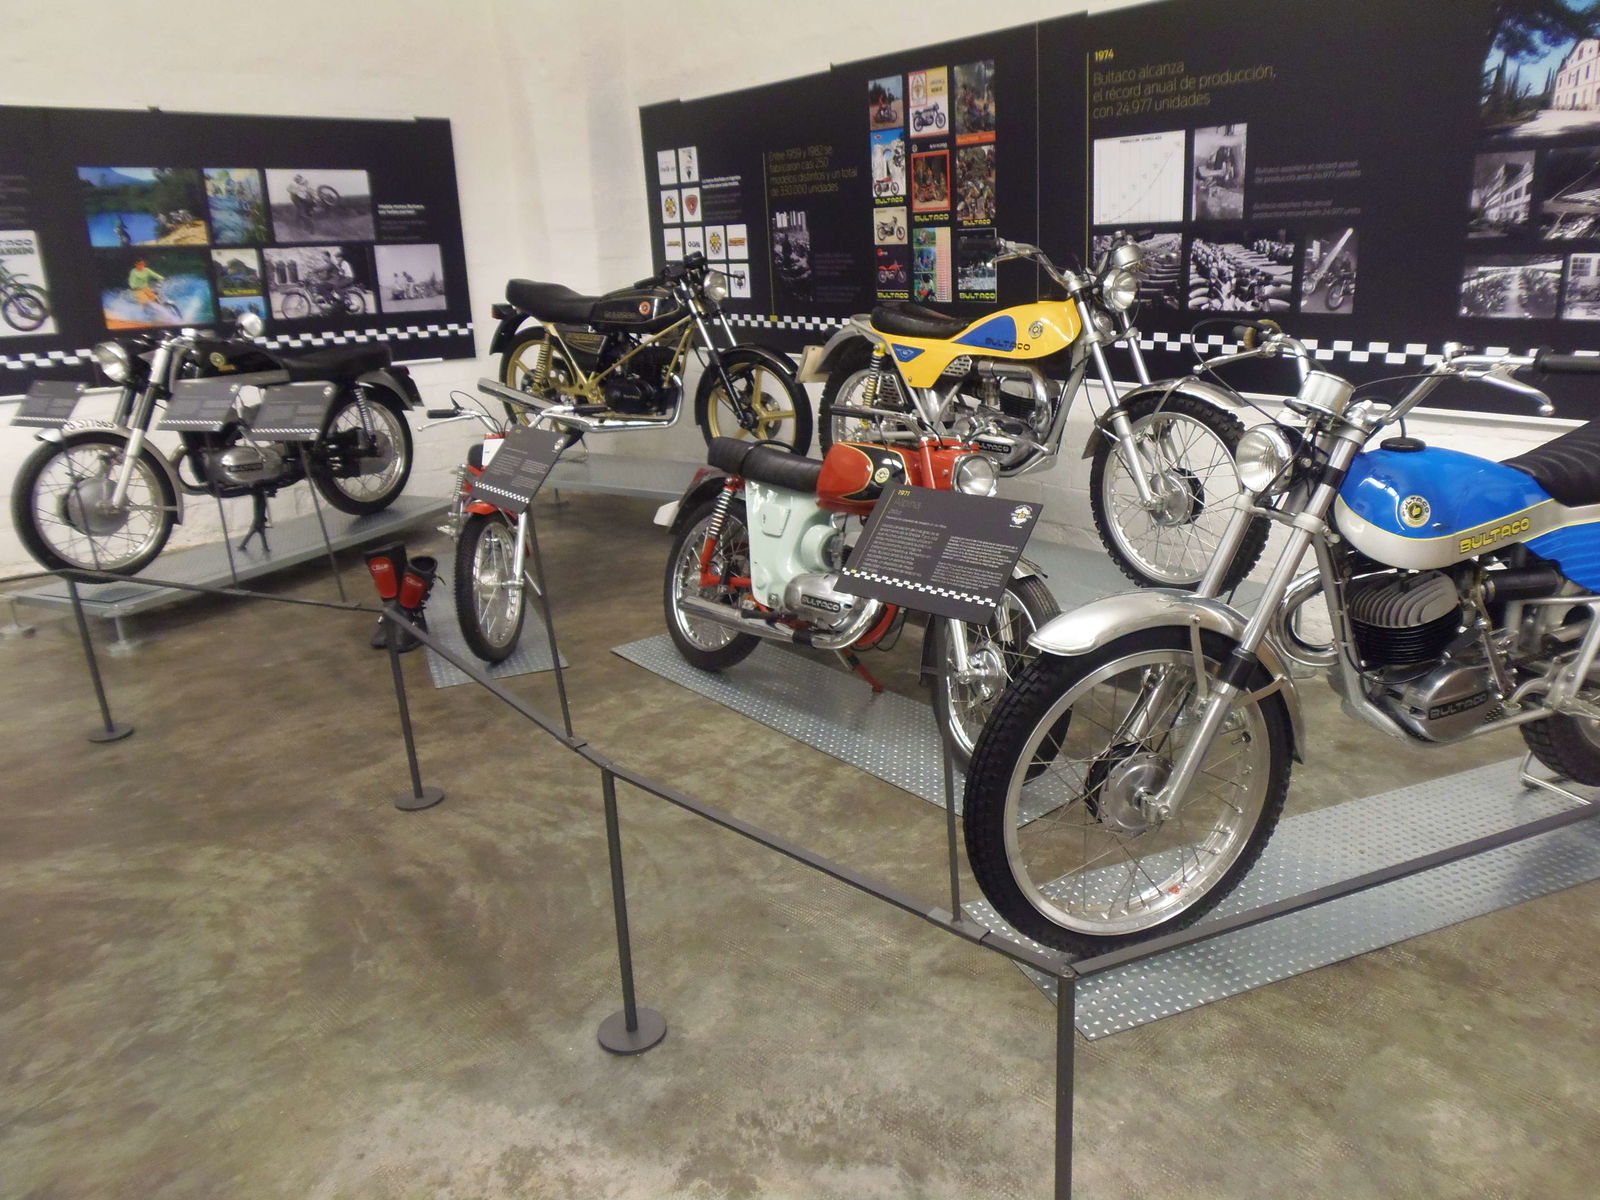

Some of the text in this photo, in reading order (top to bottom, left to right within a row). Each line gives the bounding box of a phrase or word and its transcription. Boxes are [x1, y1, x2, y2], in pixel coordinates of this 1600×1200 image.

[1093, 61, 1185, 85] Bultaco alcanza
[1093, 64, 1276, 103] el récord anual de producción,
[1093, 104, 1114, 119] con
[1154, 92, 1211, 111] unidades
[841, 166, 858, 178] total
[959, 292, 996, 300] BULTACO
[985, 337, 1031, 351] BULTACO
[1459, 517, 1531, 553] BULTACO
[802, 595, 840, 611] BULTACO
[1430, 691, 1488, 719] BULTACO
